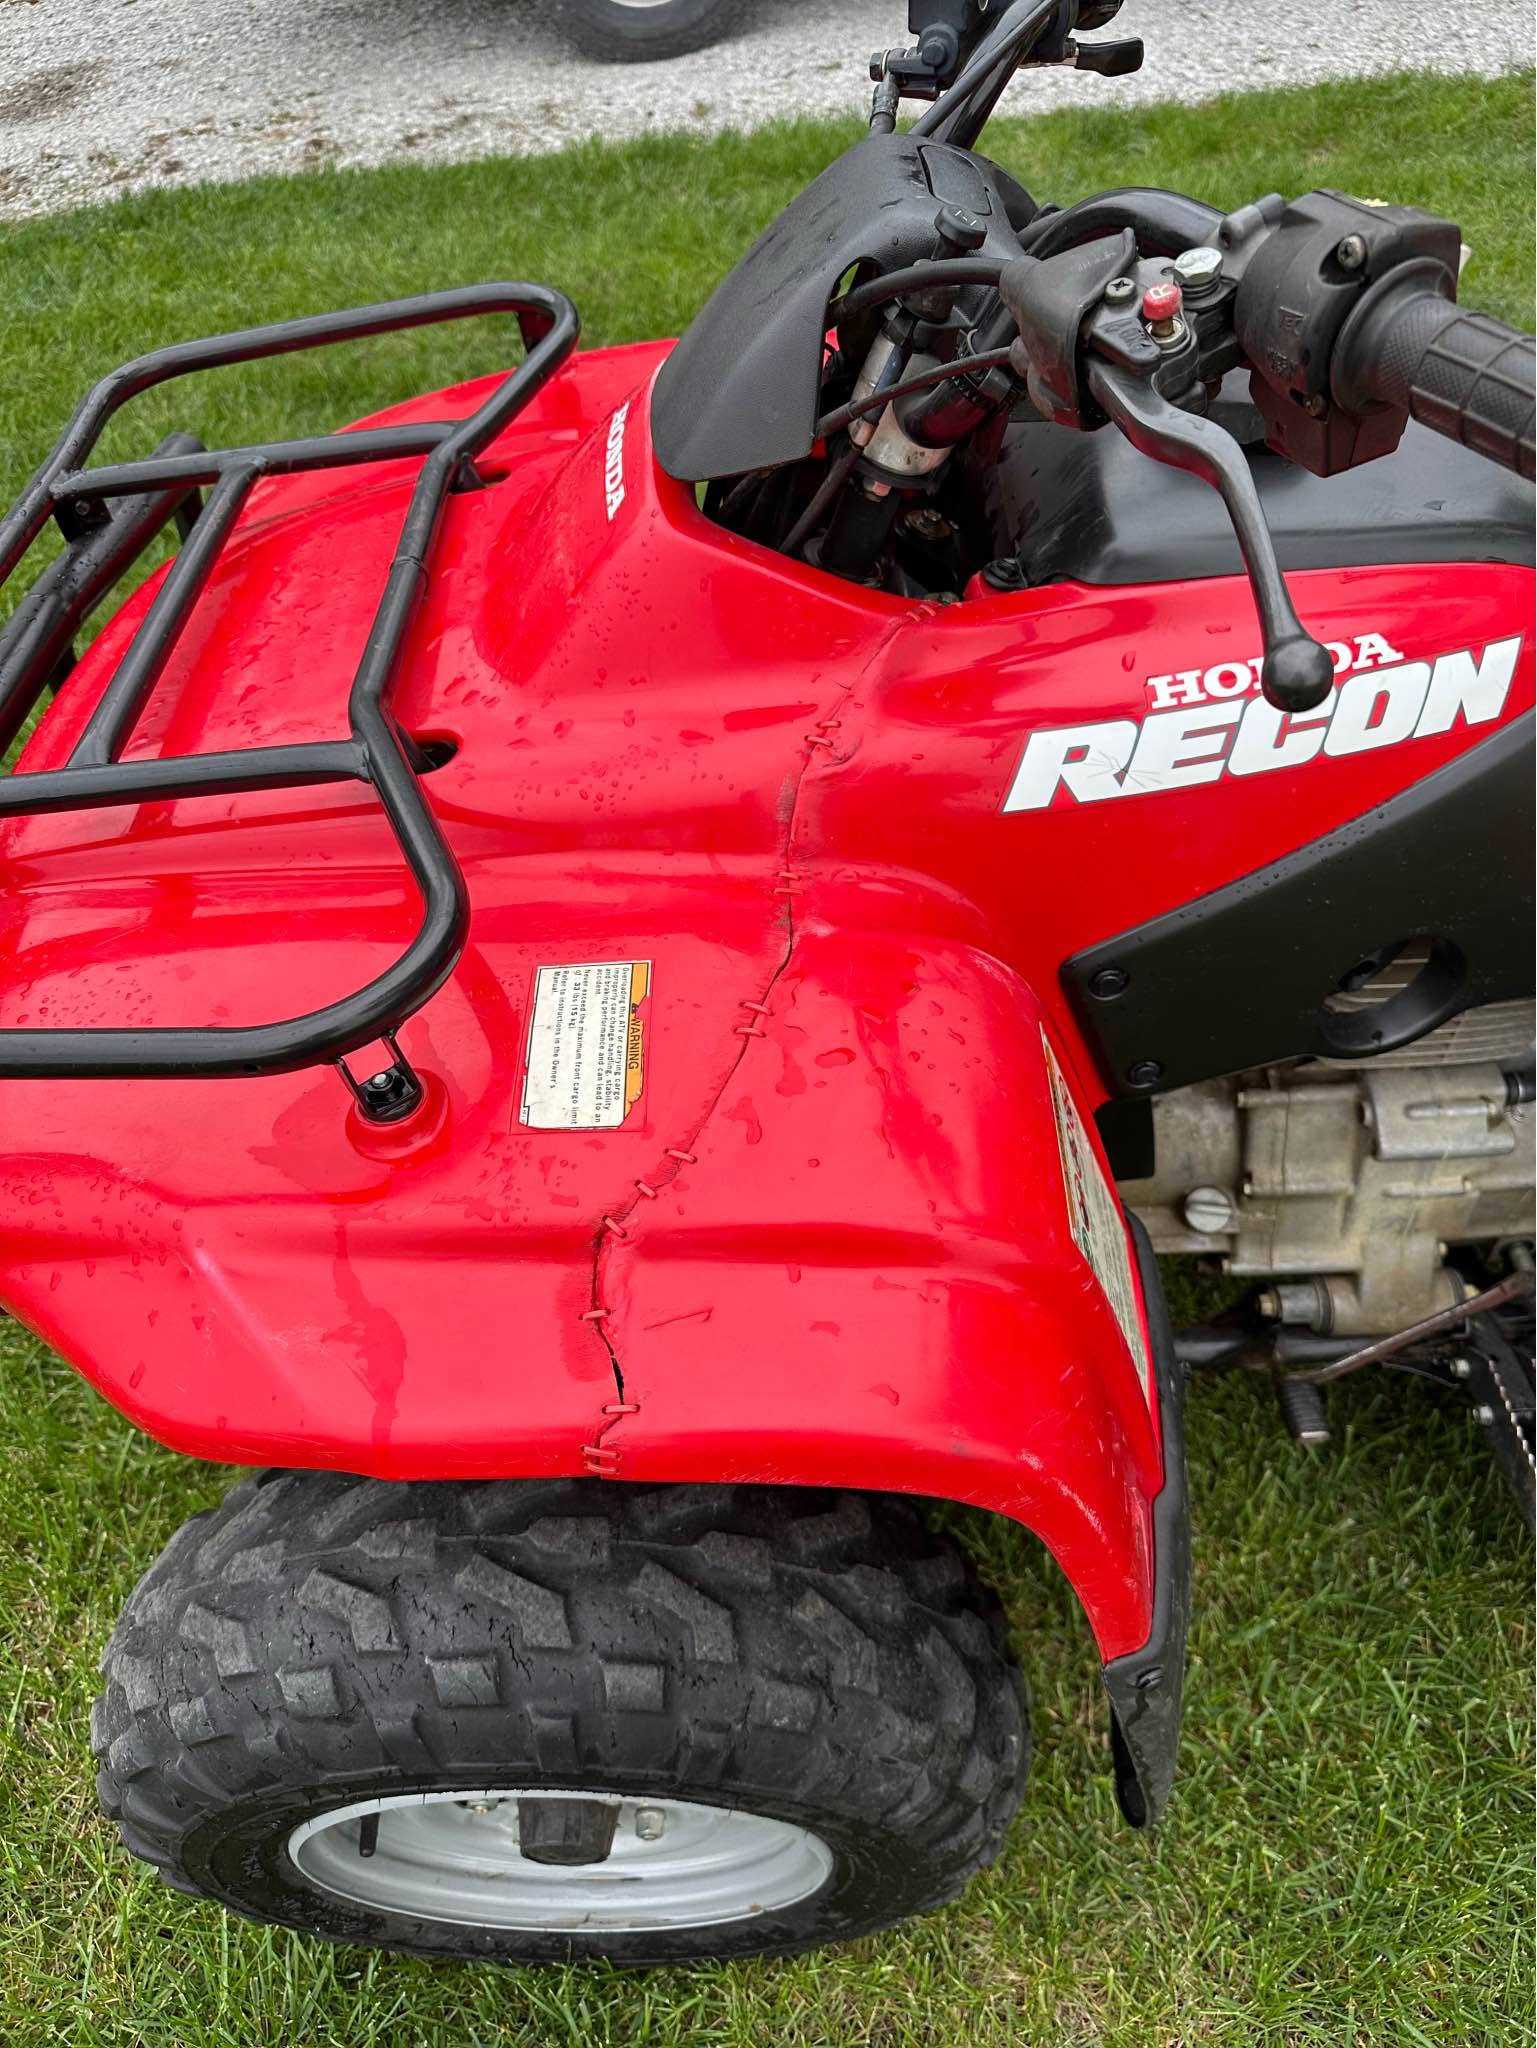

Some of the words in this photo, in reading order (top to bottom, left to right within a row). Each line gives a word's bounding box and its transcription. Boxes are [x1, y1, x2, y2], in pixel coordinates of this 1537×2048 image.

[605, 400, 630, 522] HONDA
[1148, 632, 1404, 709] HOA
[1002, 636, 1522, 814] RECON
[574, 982, 581, 990] 33
[582, 970, 591, 986] Never
[602, 981, 611, 1004] braking
[611, 968, 619, 1000] improperly
[619, 968, 629, 1004] Overloading
[555, 998, 565, 1035] instructions
[600, 1007, 608, 1049] performance
[608, 1017, 616, 1041] change
[576, 1027, 584, 1059] maximum
[574, 1062, 582, 1079] front
[614, 1046, 622, 1075] carrying
[571, 1083, 579, 1104] cargo
[596, 1084, 604, 1099] lead
[604, 1080, 612, 1110] stability
[570, 1107, 580, 1124] limit
[595, 1114, 600, 1122] an
